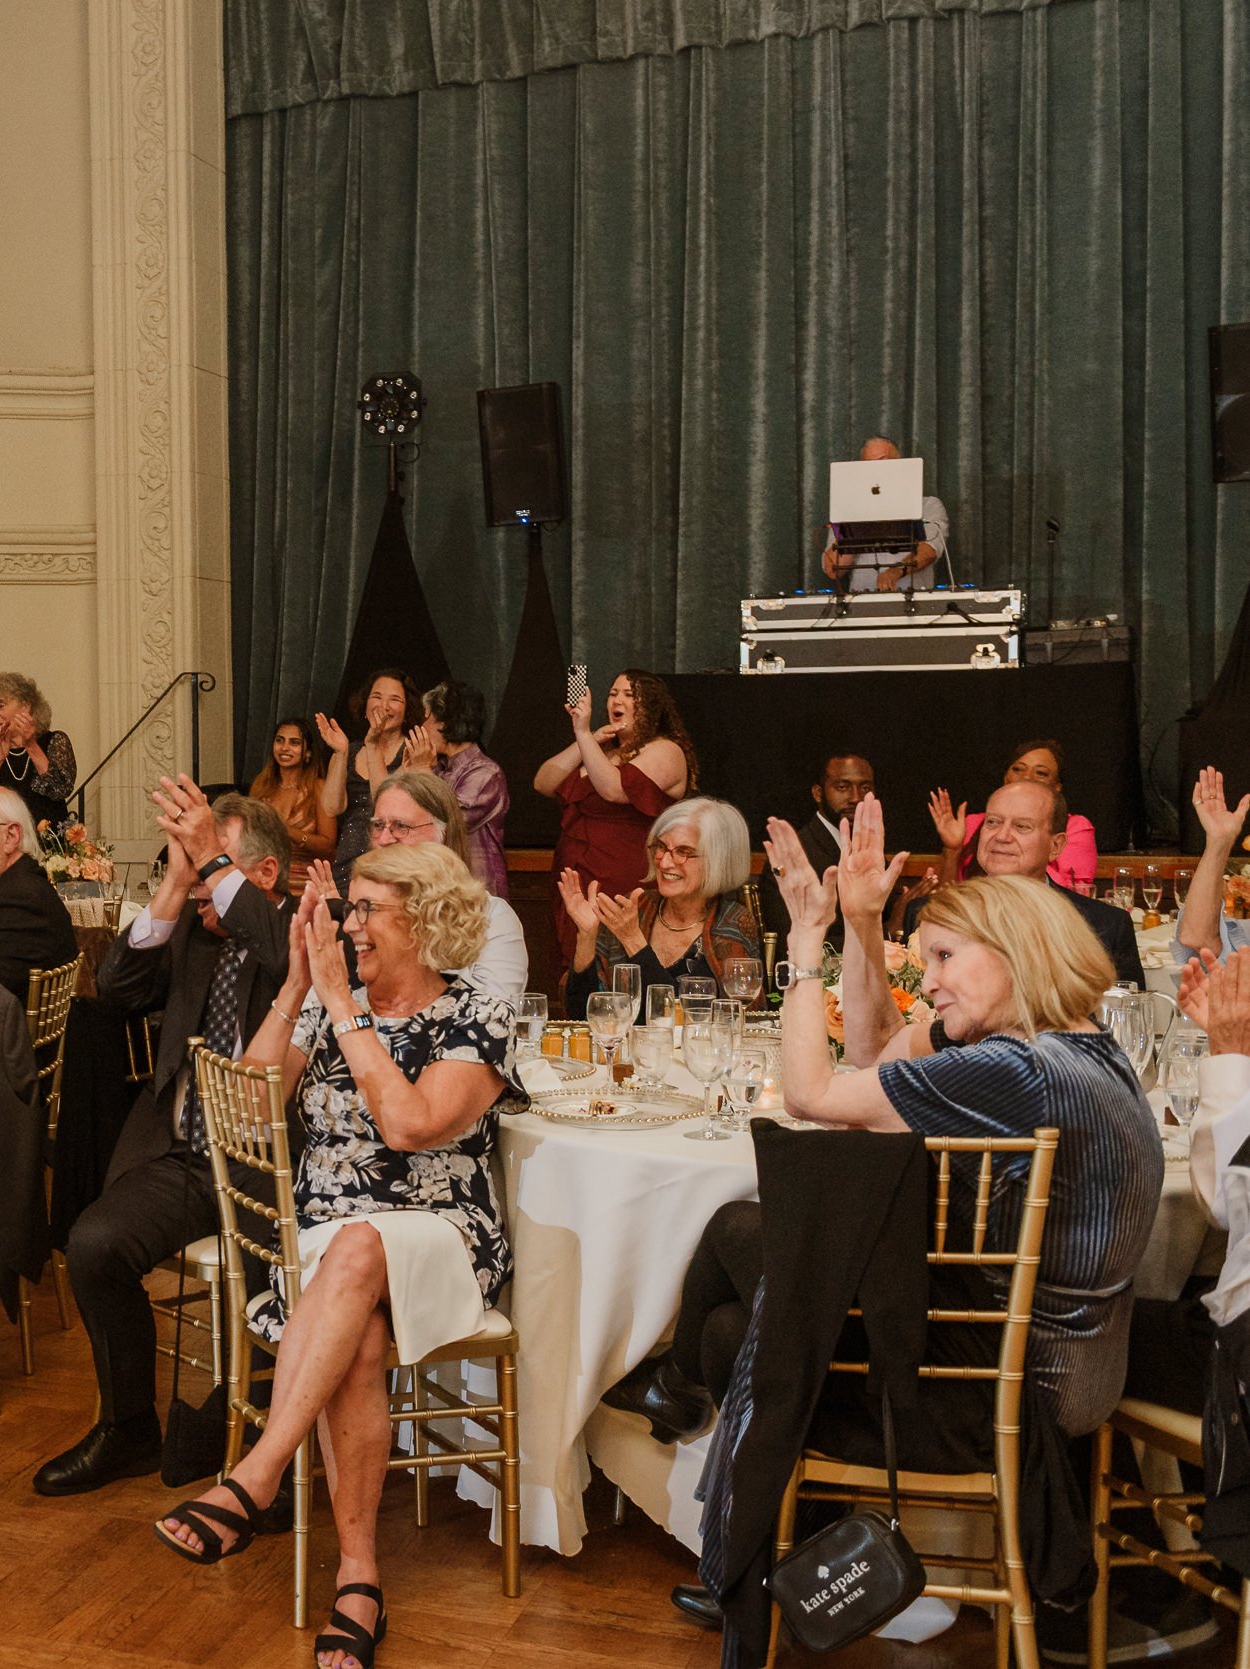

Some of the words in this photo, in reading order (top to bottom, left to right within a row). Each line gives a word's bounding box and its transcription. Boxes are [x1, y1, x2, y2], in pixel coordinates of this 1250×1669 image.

[800, 1589, 831, 1614] kate
[830, 1561, 870, 1594] spade
[827, 1601, 845, 1616] NEW
[843, 1586, 866, 1605] YORK
